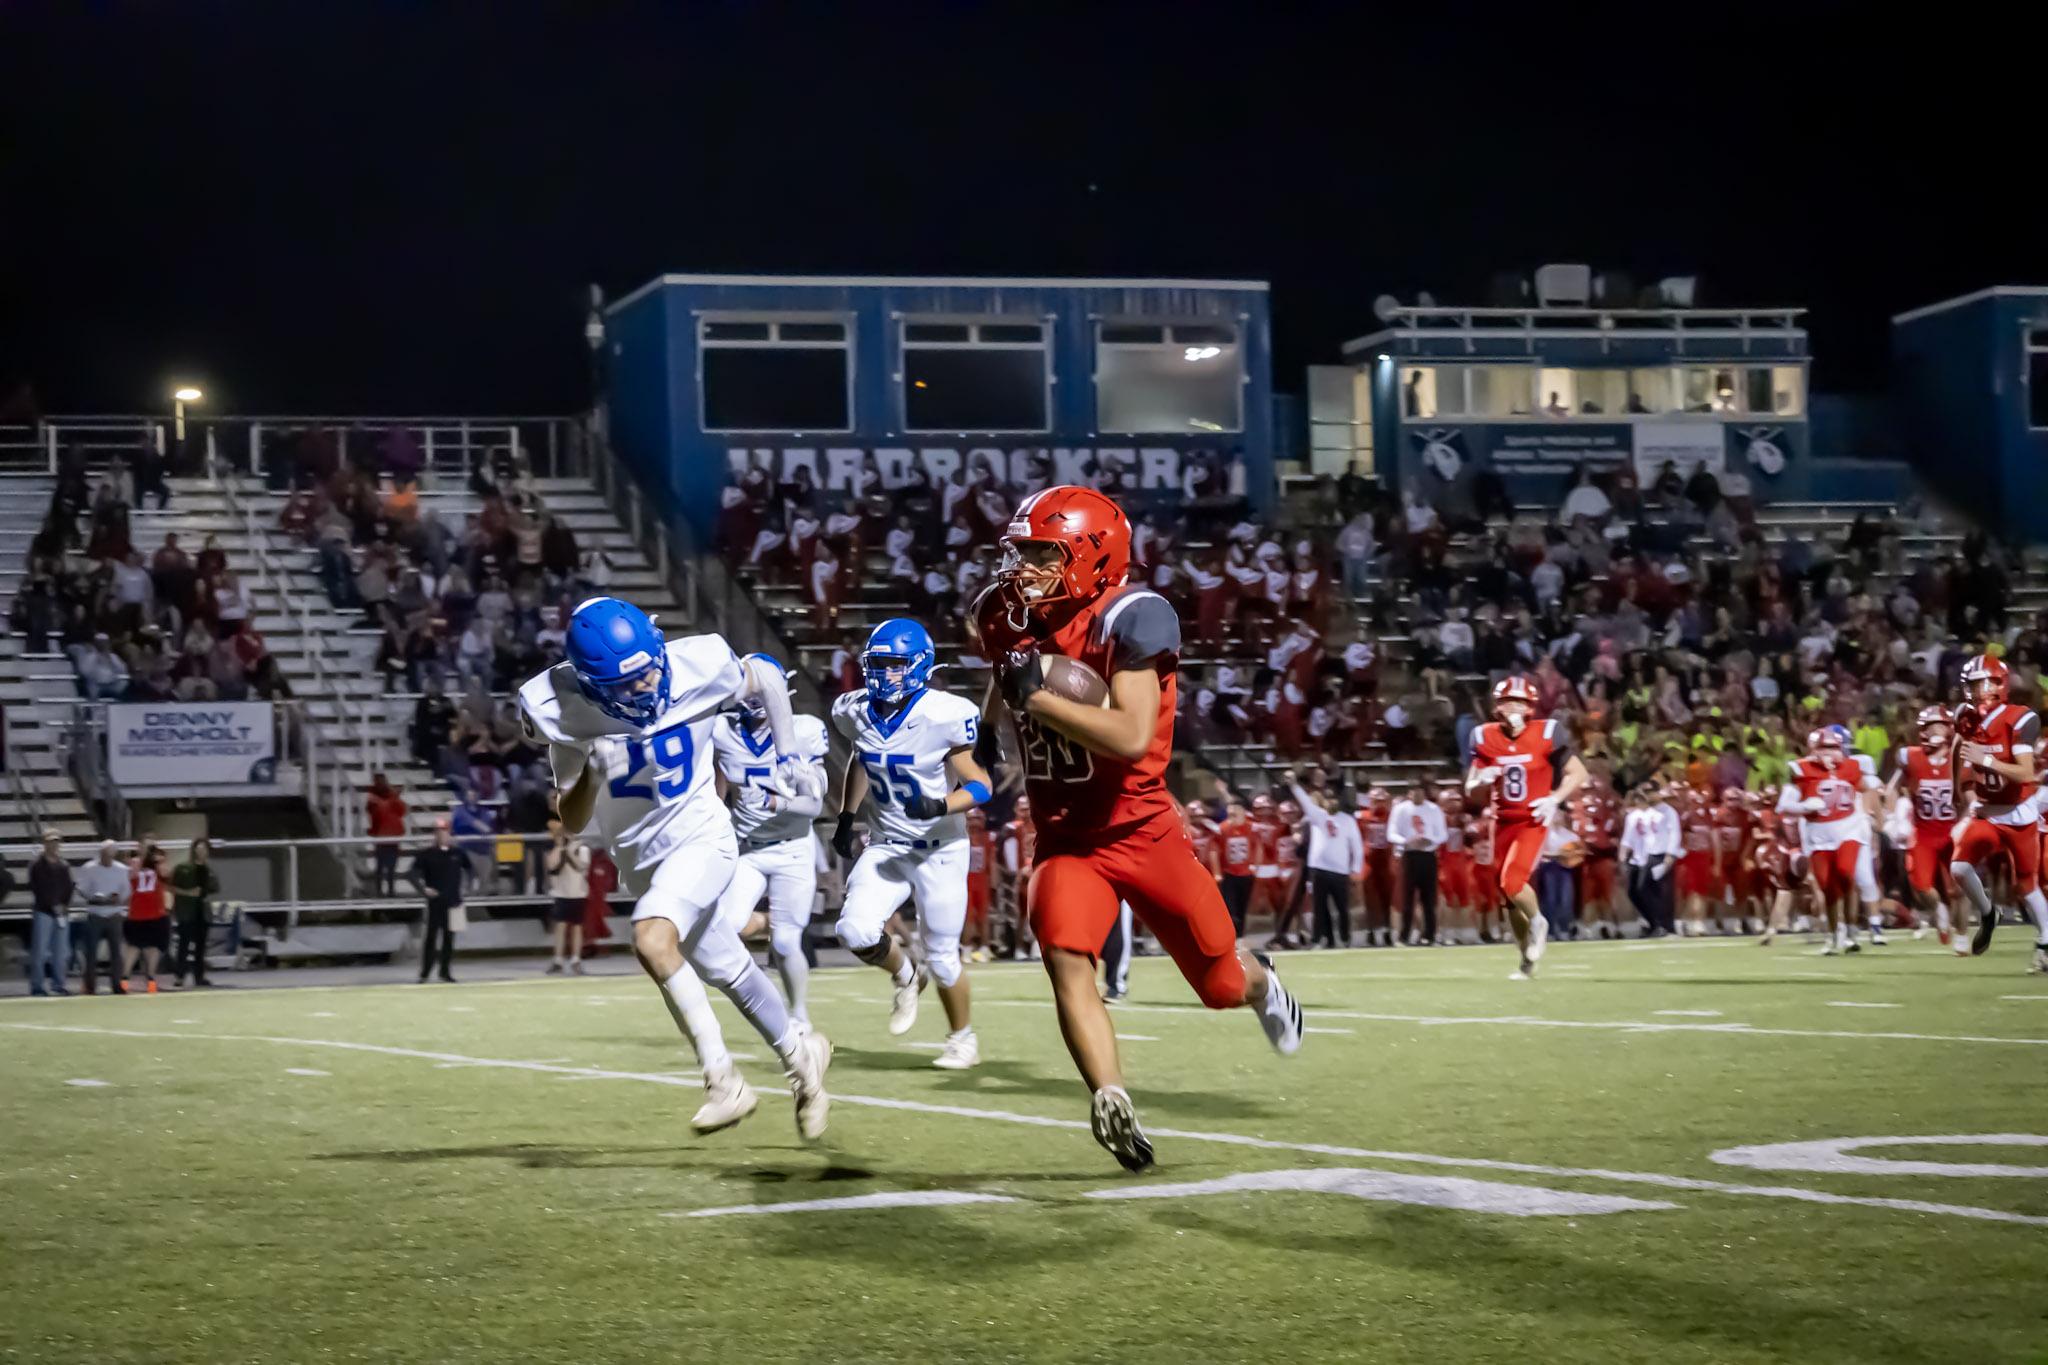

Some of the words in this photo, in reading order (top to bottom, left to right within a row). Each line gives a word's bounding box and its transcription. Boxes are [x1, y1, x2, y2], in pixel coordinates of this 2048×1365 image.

[128, 726, 251, 742] MENHOLT
[143, 712, 234, 726] DENNY
[609, 723, 693, 799] 29
[860, 751, 922, 806] 55
[1503, 764, 1527, 802] 8
